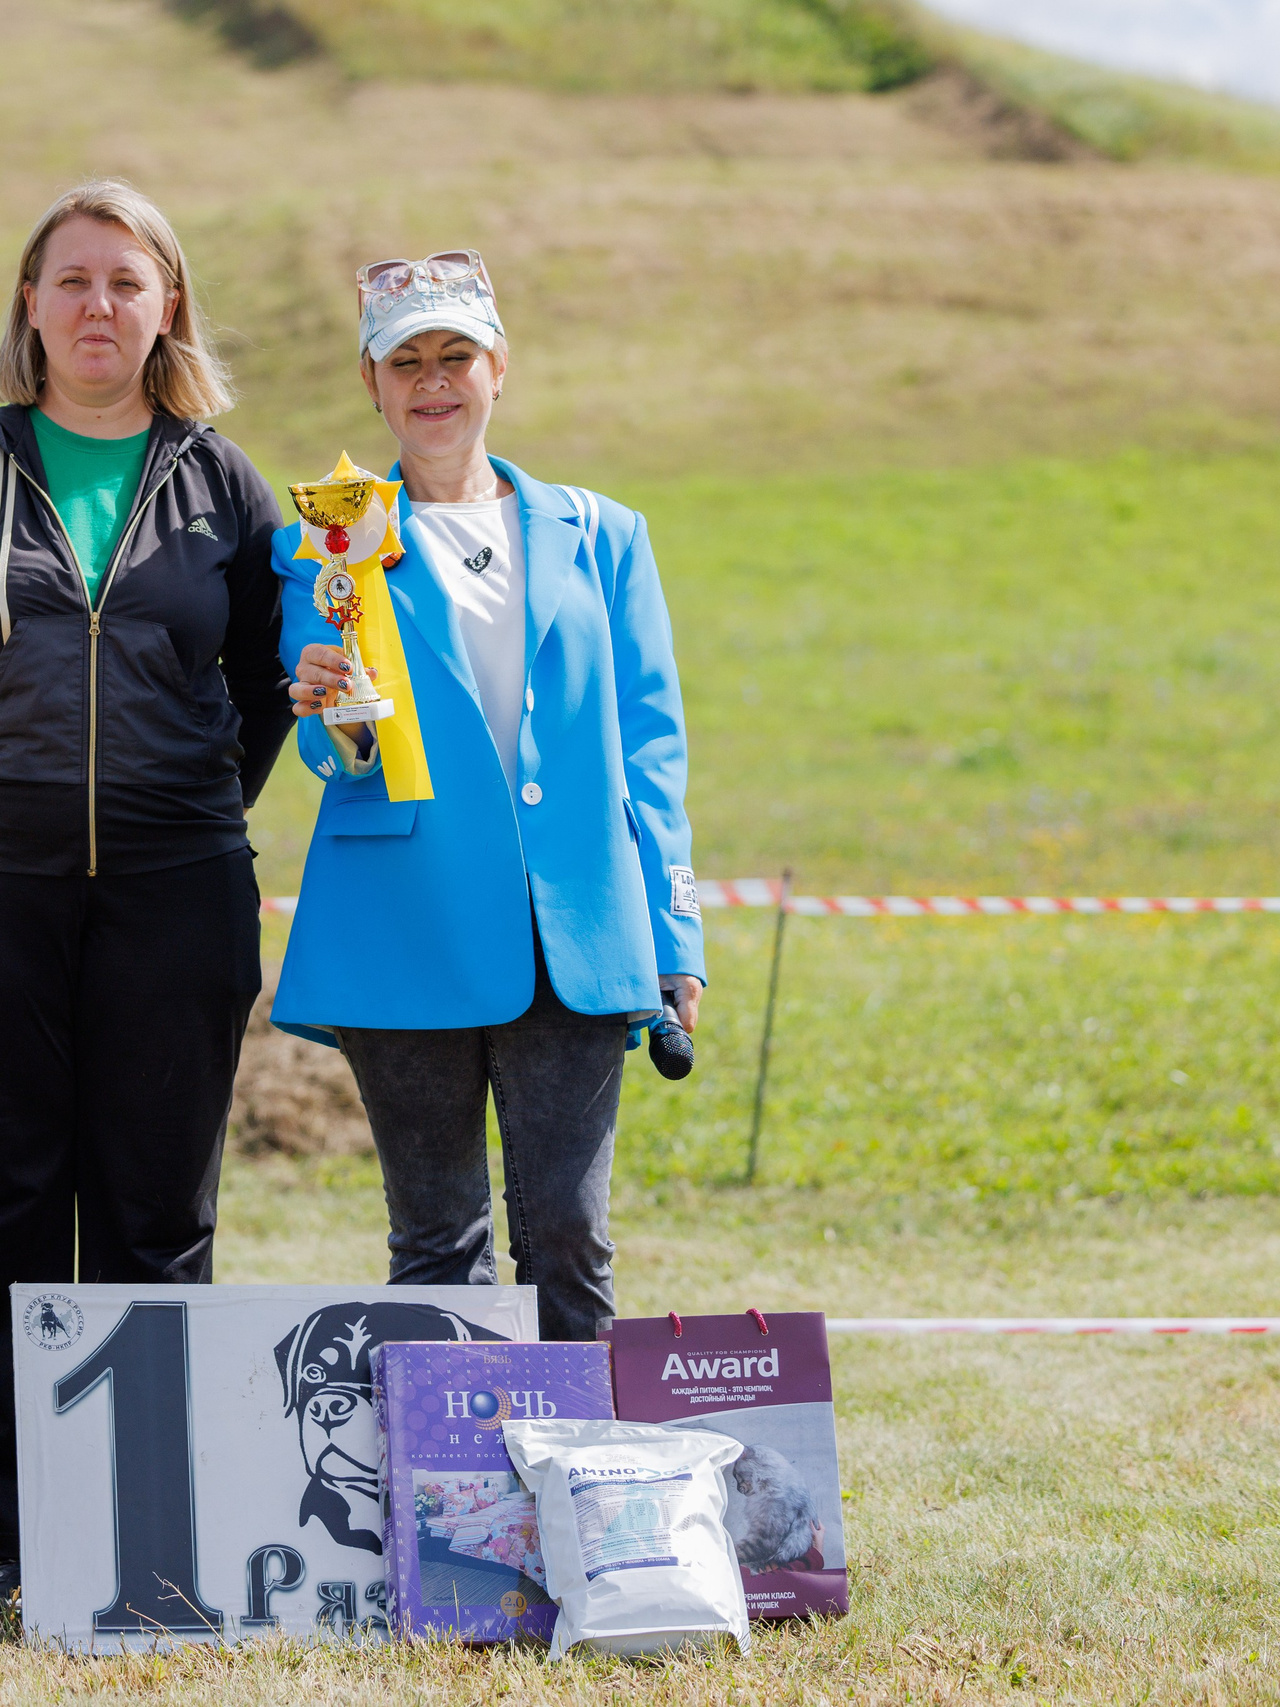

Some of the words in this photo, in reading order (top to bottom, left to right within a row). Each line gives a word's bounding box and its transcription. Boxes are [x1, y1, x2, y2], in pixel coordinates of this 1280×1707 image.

[188, 526, 218, 541] adidas
[51, 1295, 72, 1304] КЛУБ
[73, 1304, 84, 1336] РОССИИ
[483, 1355, 512, 1364] БЯЗЬ
[661, 1348, 780, 1380] Award
[671, 1386, 699, 1395] КАЖДЫЙ
[699, 1386, 727, 1394] ПИТОМЕЦ
[690, 1394, 726, 1404] ДОСТОЙНЫЙ
[726, 1394, 756, 1403] НАГРАДЫ!
[52, 1301, 224, 1632] 1
[504, 1596, 524, 1609] 2,0
[757, 1601, 780, 1609] КОШЕК
